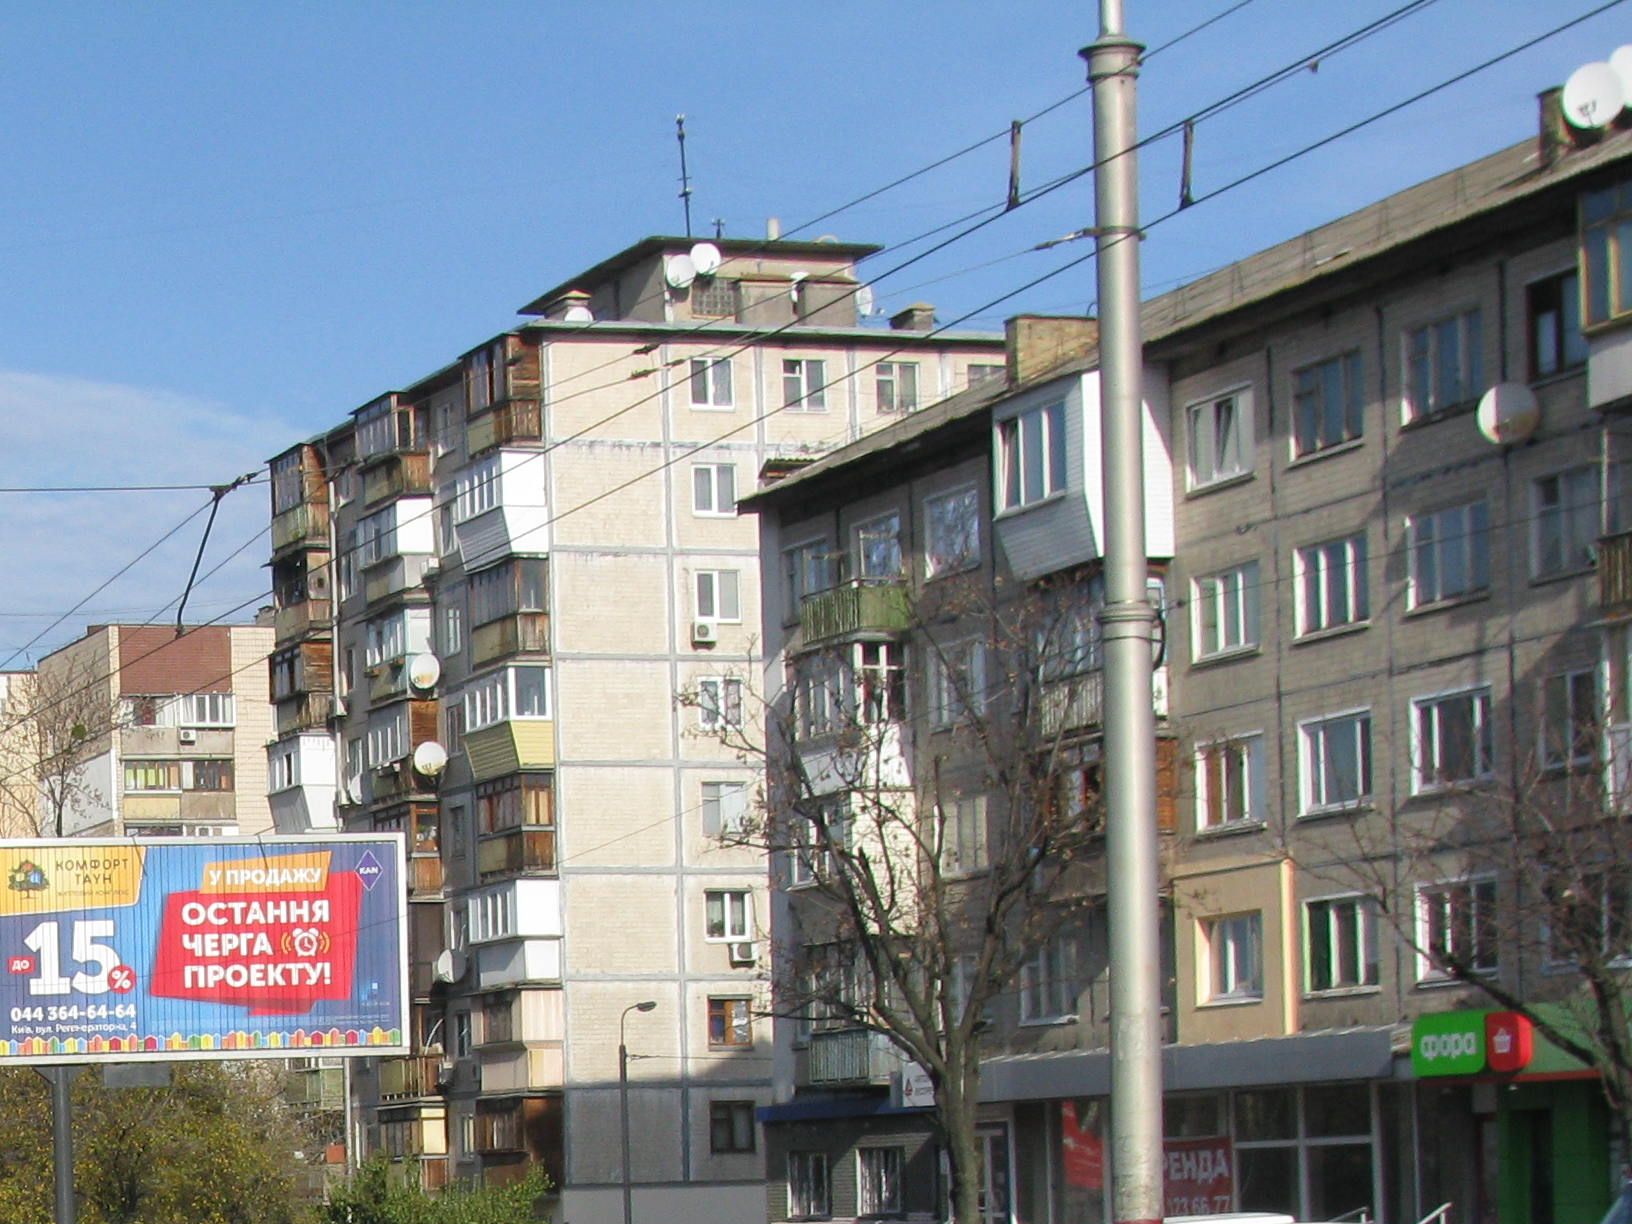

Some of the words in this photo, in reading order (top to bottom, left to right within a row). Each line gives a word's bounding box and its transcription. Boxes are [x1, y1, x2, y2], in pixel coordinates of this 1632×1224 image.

[54, 858, 128, 871] КОМФОРТ
[359, 867, 378, 875] KAN
[74, 873, 113, 885] ТАУН
[209, 870, 222, 886] У
[226, 867, 322, 887] ПРОДАЖУ
[181, 899, 330, 926] ОСТАННЯ
[181, 932, 273, 957] ЧЕРГА
[184, 962, 332, 988] ПРОЕКТУ!
[10, 1006, 44, 1022] 044
[47, 1003, 137, 1021] 364-64-64
[1420, 1031, 1476, 1061] фора
